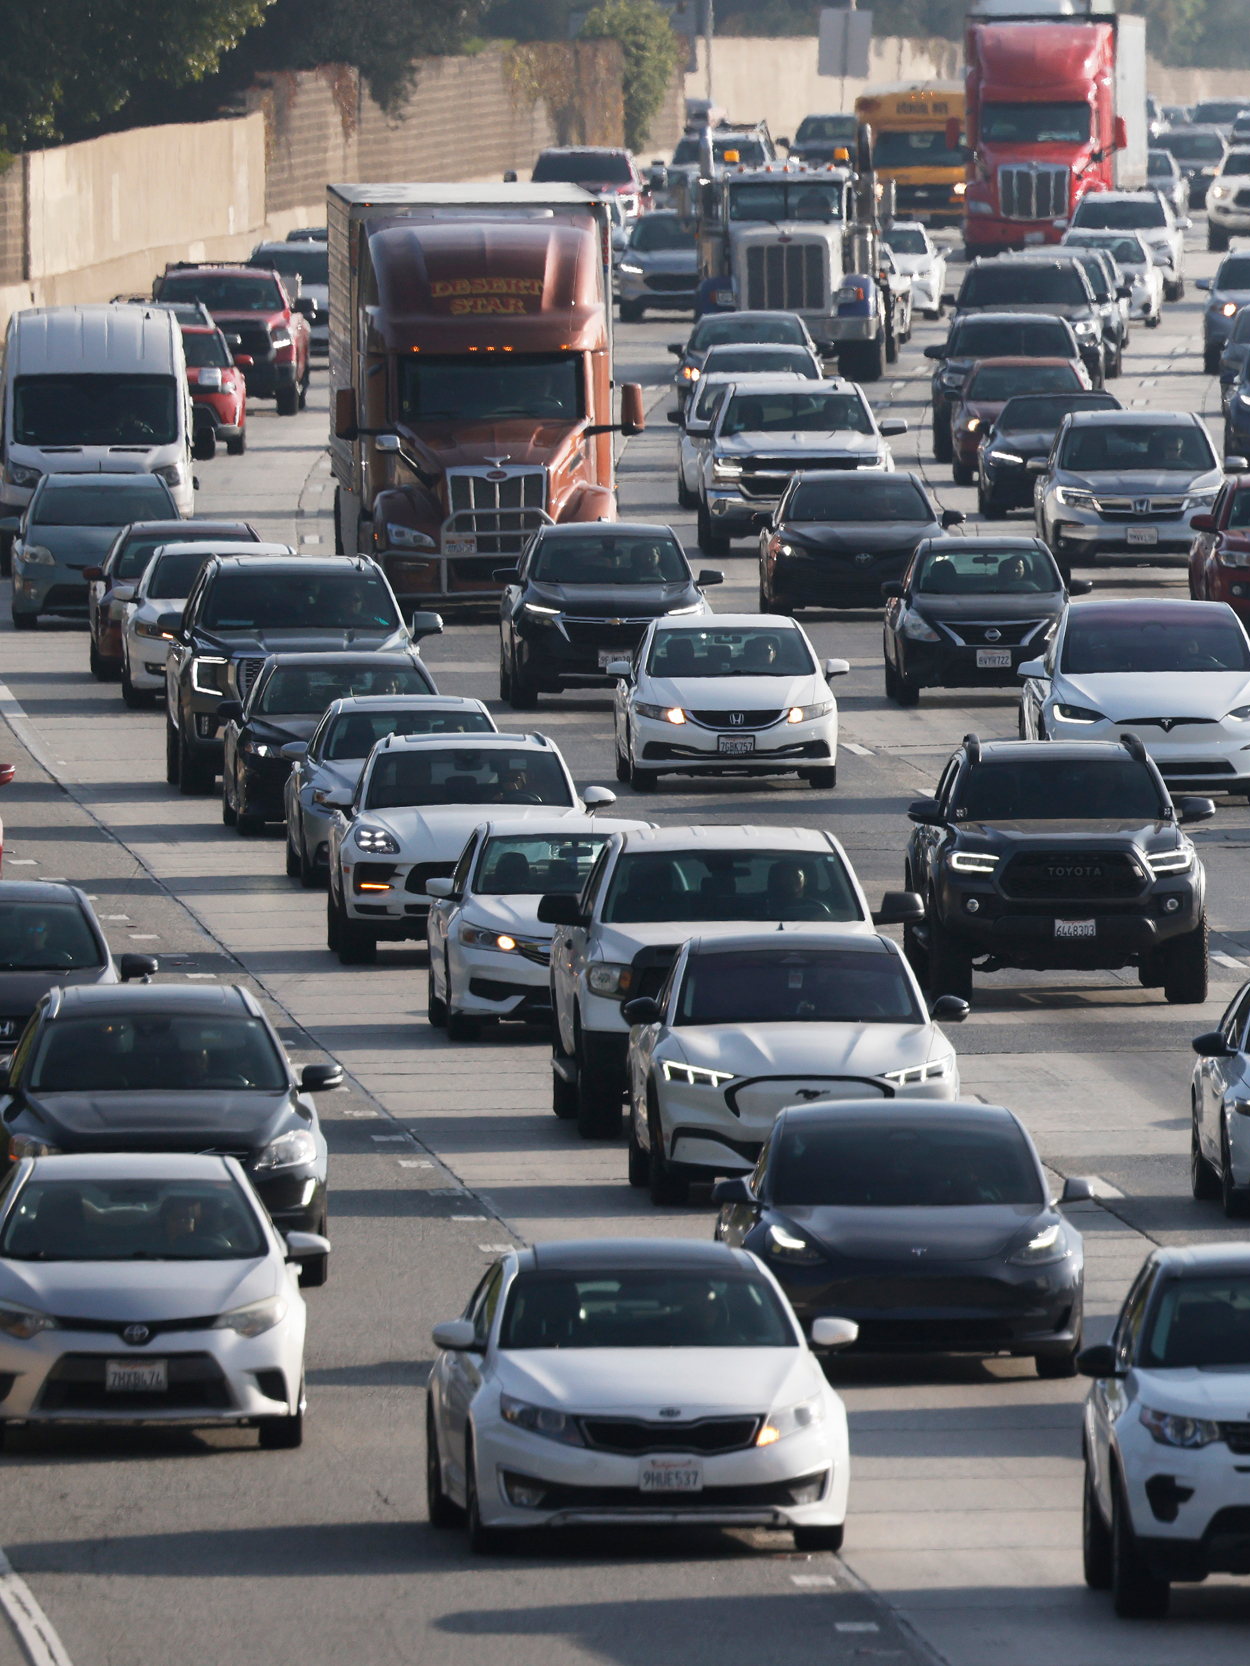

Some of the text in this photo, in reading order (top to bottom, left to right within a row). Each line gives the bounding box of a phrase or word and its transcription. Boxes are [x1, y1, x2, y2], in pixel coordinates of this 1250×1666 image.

[431, 278, 543, 297] DESERT
[450, 298, 526, 315] STAR
[1048, 867, 1101, 876] TOYOTA
[643, 1471, 699, 1486] 9HUE537
